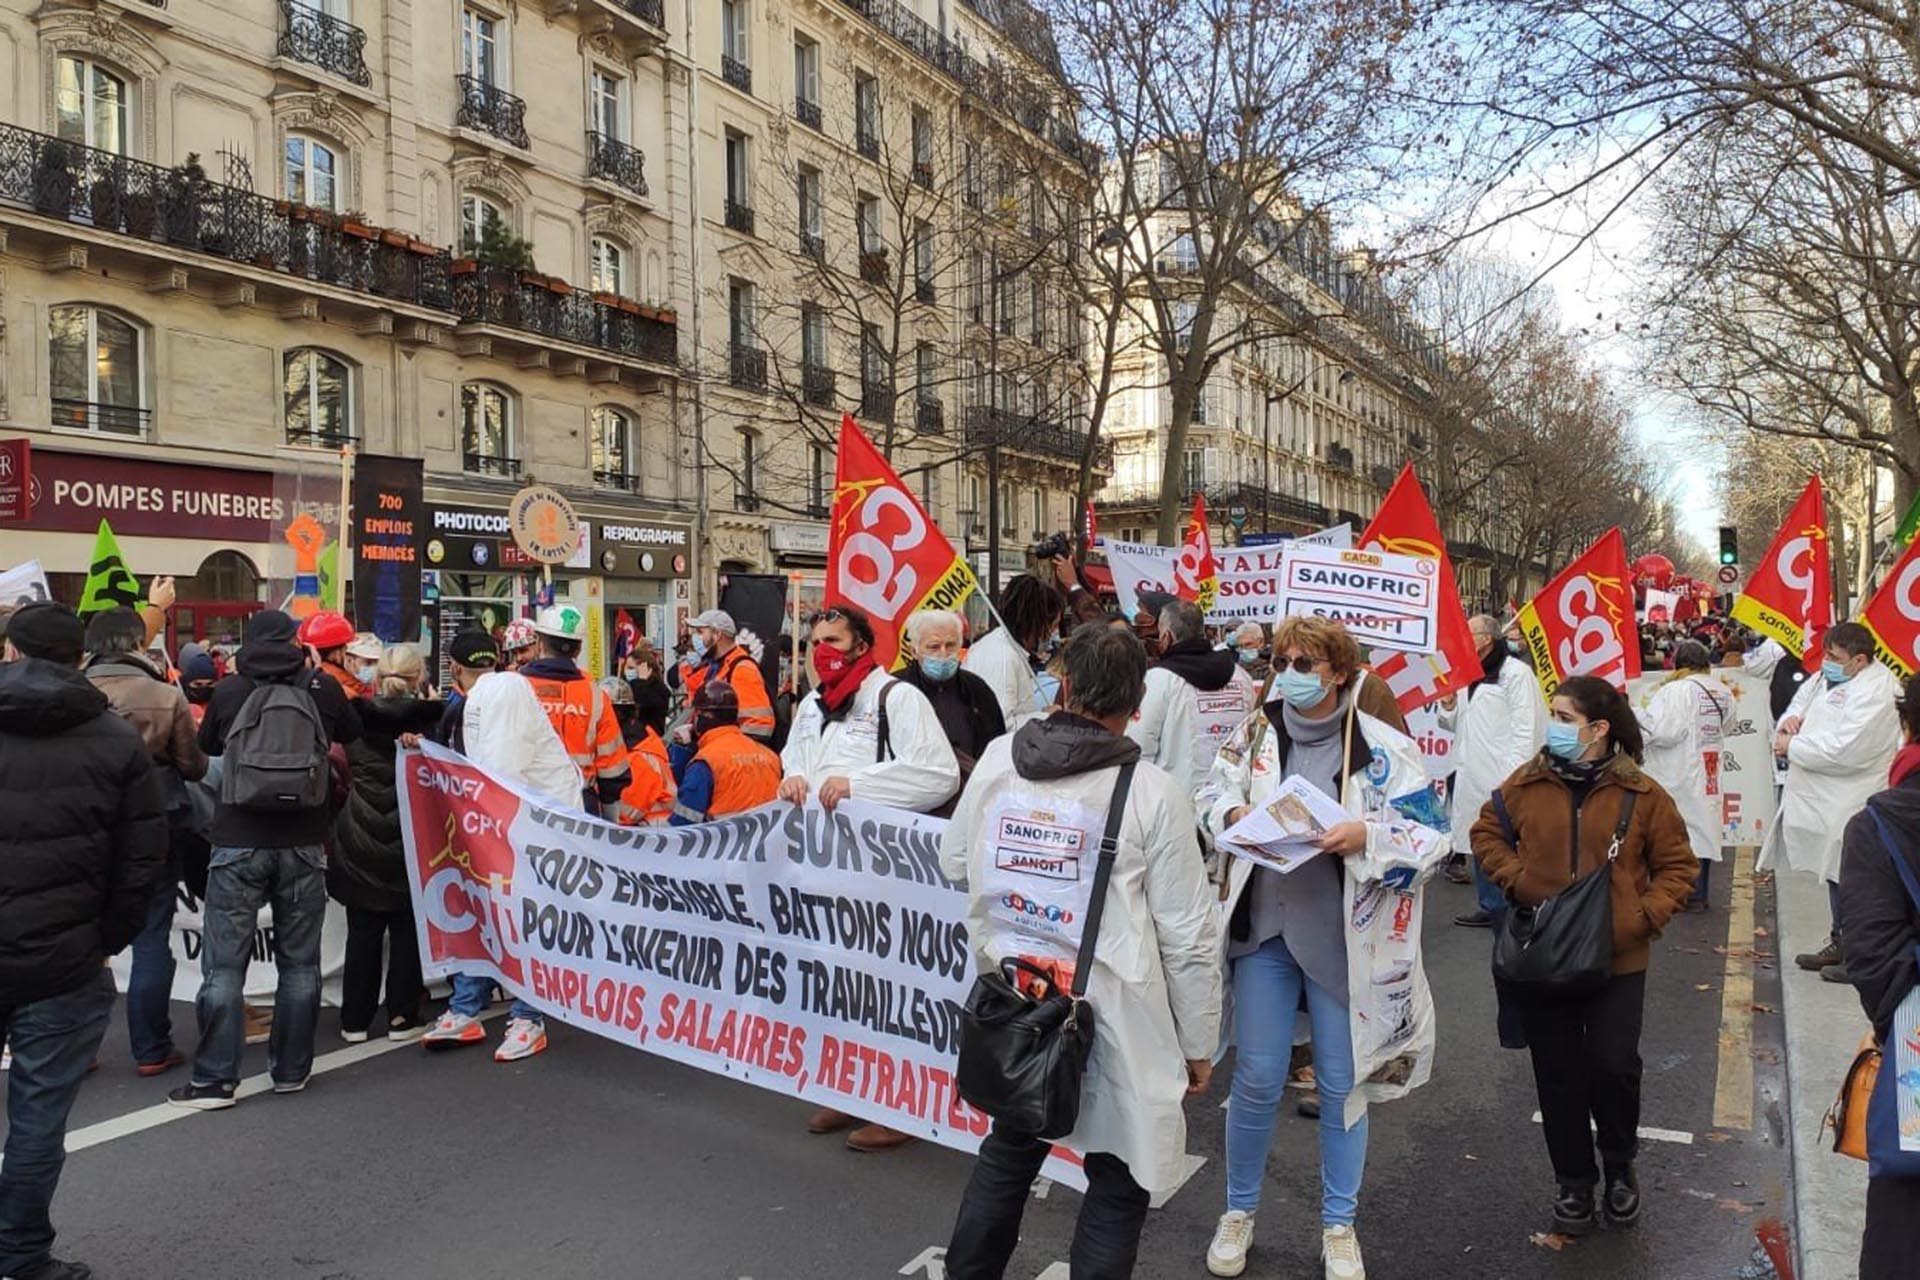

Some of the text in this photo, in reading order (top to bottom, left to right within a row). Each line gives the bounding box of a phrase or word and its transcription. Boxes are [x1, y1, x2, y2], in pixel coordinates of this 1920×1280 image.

[54, 479, 164, 511] POMPES
[172, 489, 284, 519] FUNEBRES
[378, 493, 403, 510] 700
[365, 517, 414, 535] EMPLOIS
[602, 524, 687, 545] REPROGRAPHIE
[1114, 544, 1166, 557] RENAULT
[1342, 550, 1381, 566] CAC40
[1219, 578, 1277, 598] SOCI
[1297, 567, 1422, 598] SANOFRIC
[1203, 606, 1257, 620] enault
[1312, 607, 1402, 634] SANOFI
[1528, 626, 1553, 683] SANOFI
[416, 766, 485, 801] SANOFI
[783, 805, 863, 873] SUR
[1004, 822, 1078, 845] SANOFRIC
[1010, 854, 1064, 873] SANOFI
[524, 843, 605, 900] TOUS
[768, 883, 892, 959] BATTONS
[899, 906, 970, 983] NOUS
[521, 896, 963, 1056] POUR L'AVENIR DES TRAVAILLEUR
[529, 957, 650, 1045] EMPLOIS,
